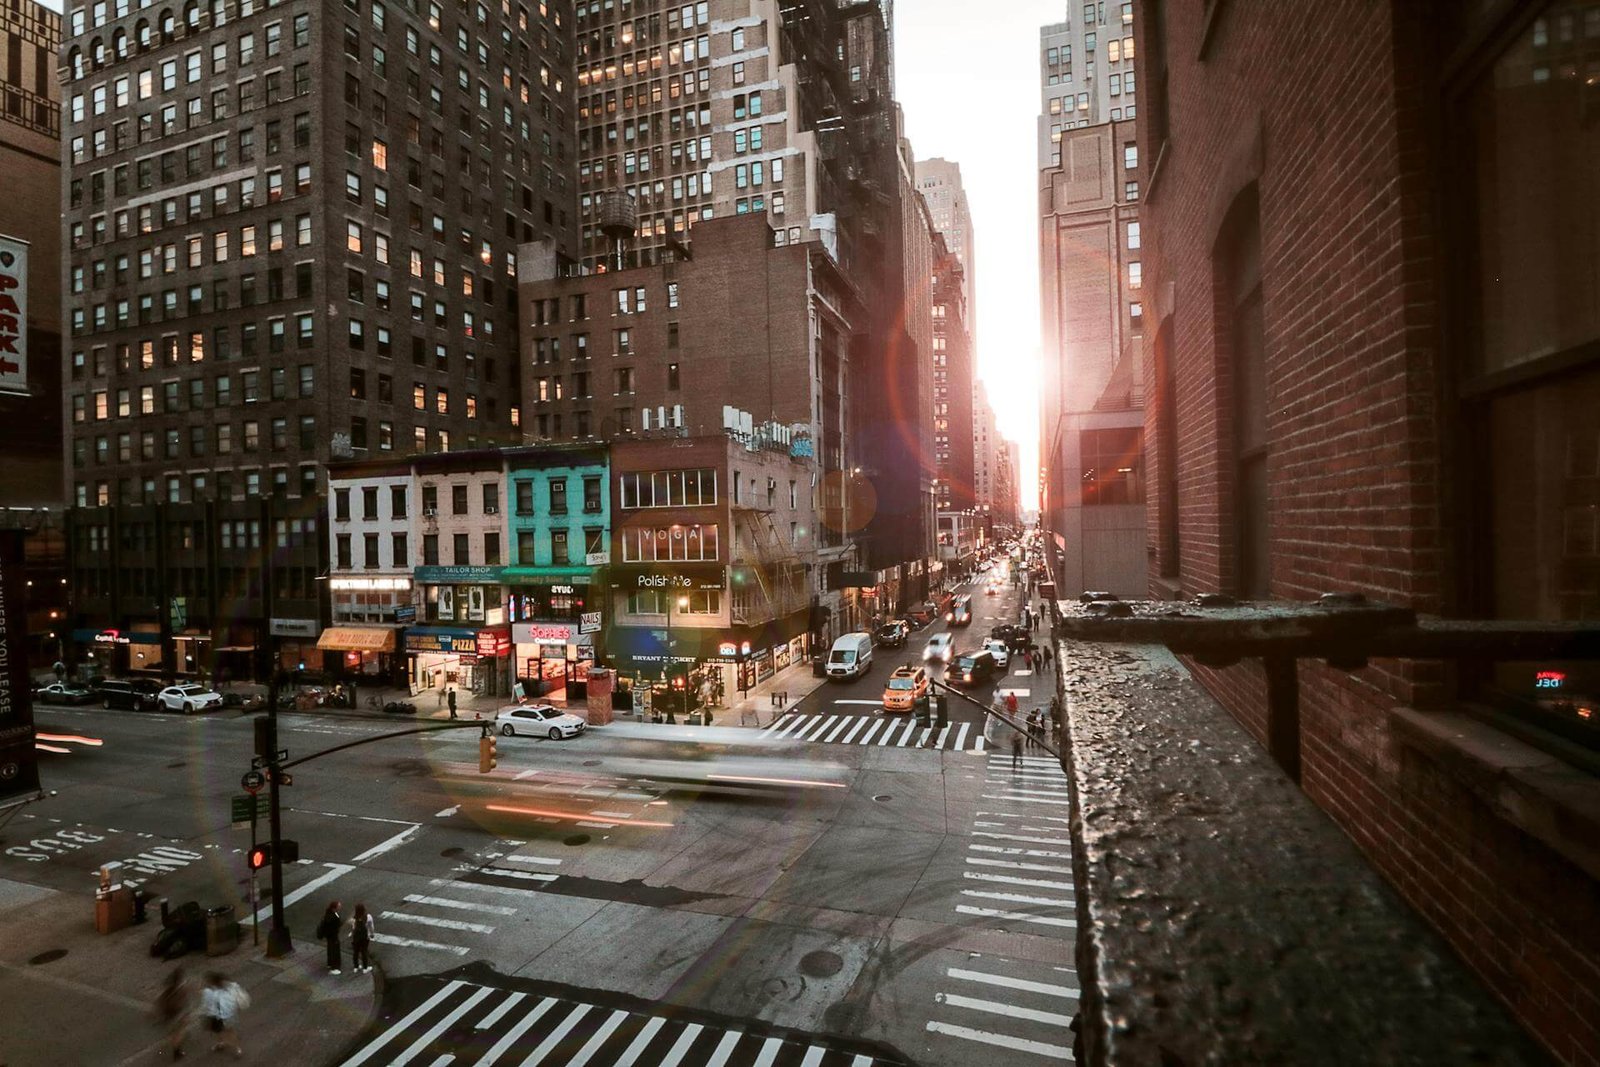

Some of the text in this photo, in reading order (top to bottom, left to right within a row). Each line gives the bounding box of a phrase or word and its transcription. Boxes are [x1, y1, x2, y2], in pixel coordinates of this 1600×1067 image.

[643, 530, 698, 540] YOGA
[582, 612, 599, 624] NAILS
[452, 638, 476, 651] PIZZA
[720, 647, 736, 656] DELI
[0, 672, 11, 713] LEASE
